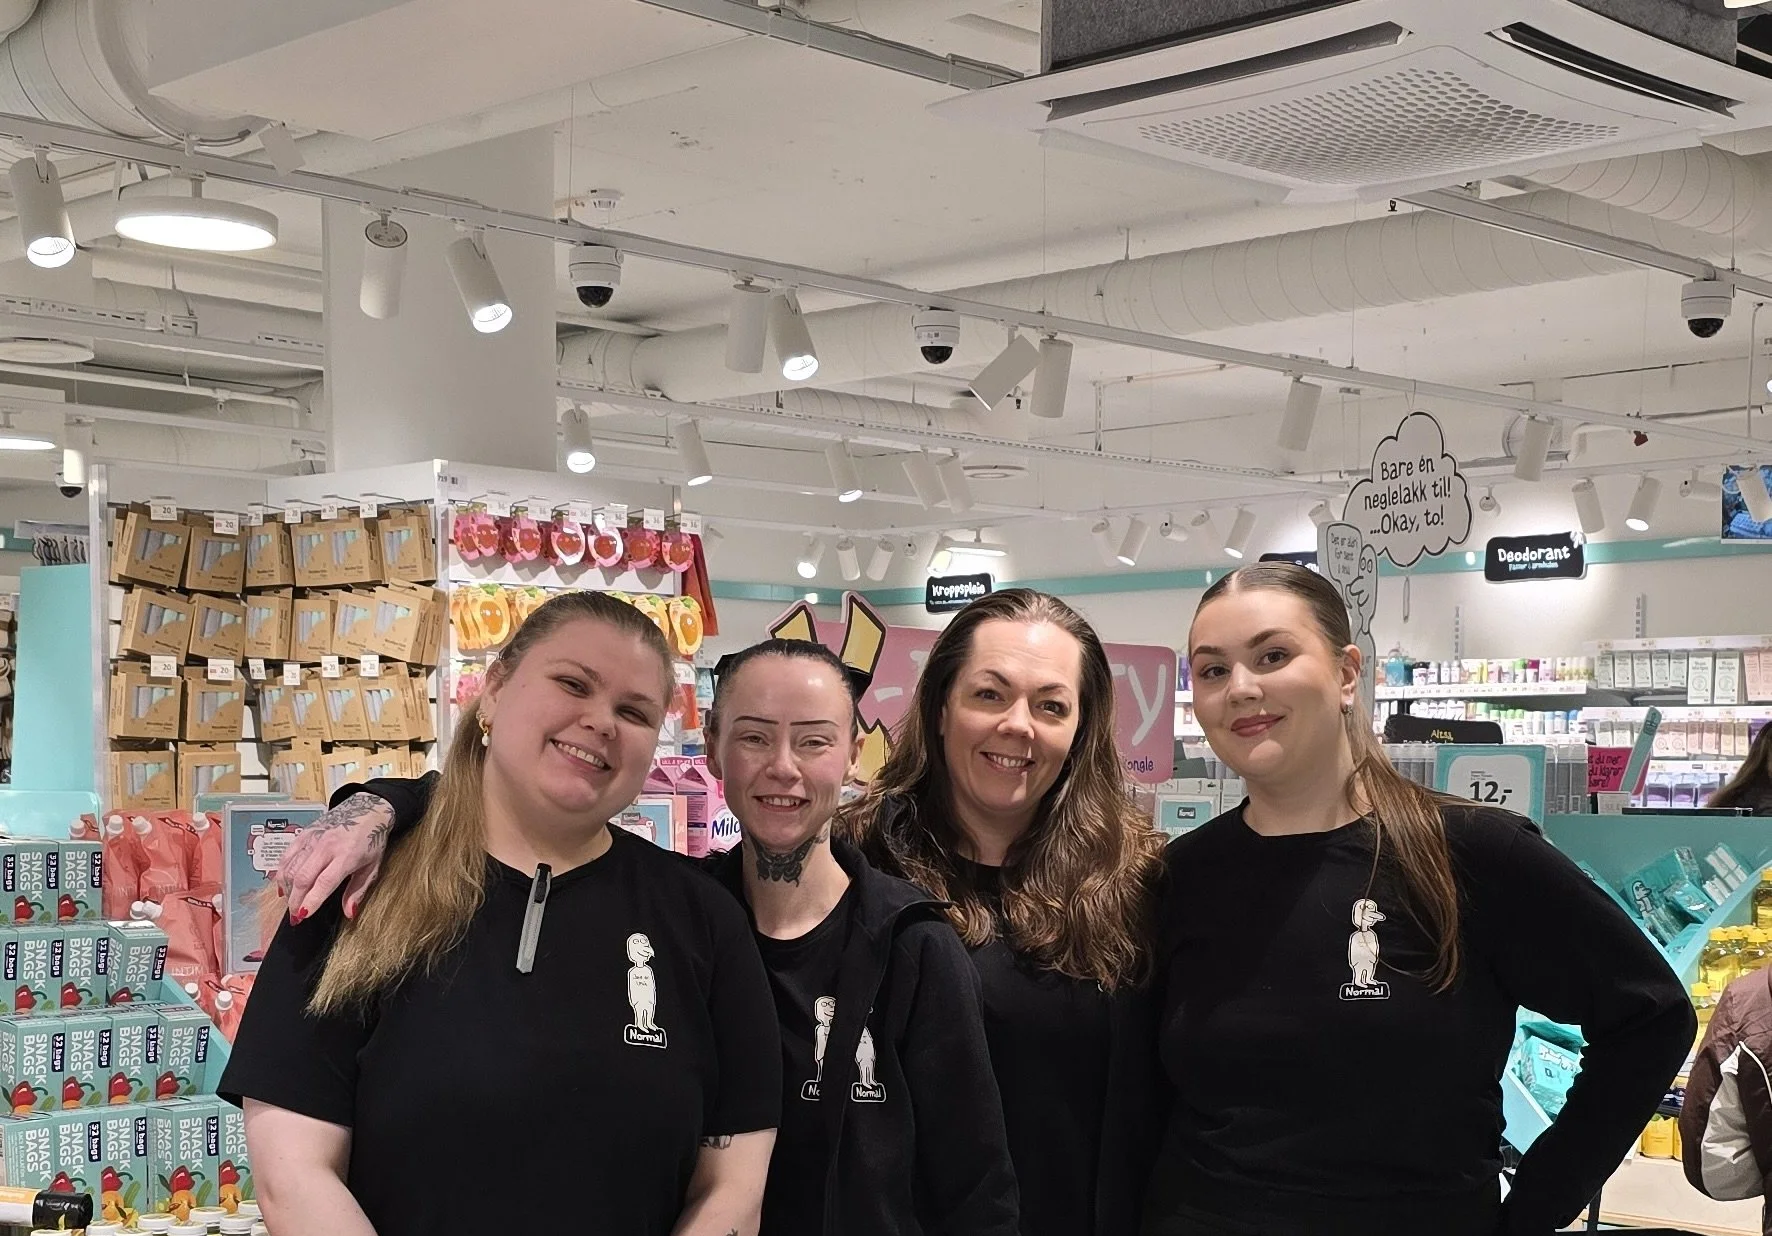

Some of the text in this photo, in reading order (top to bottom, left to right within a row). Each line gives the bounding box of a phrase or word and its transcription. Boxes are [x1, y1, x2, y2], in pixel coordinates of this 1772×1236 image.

[1381, 455, 1435, 480] Bare én
[1364, 476, 1451, 511] neglelakk til!
[1370, 504, 1444, 534] ...Okay, to!
[1497, 546, 1571, 562] Deodorant
[932, 582, 986, 598] Kroppspleie
[19, 852, 31, 891] BAGS
[32, 852, 43, 900] SNACK
[65, 851, 76, 889] BAGS
[76, 851, 88, 898] SNACK
[23, 940, 35, 980] BAGS
[34, 940, 47, 989] SNACK
[69, 938, 81, 977] BAGS
[80, 938, 93, 987] SNACK
[125, 946, 141, 983] BAGS
[134, 945, 153, 992] SNACK
[1345, 986, 1384, 997] Normal
[22, 1034, 35, 1076] BAGS
[70, 1031, 83, 1072] BAGS
[82, 1029, 95, 1081] SNACK
[118, 1026, 131, 1067] BAGS
[129, 1025, 142, 1077] SNACK
[168, 1028, 183, 1068] BAGS
[177, 1026, 194, 1076] SNACK
[629, 1028, 663, 1043] Normal
[34, 1033, 48, 1085] SNACK
[855, 1086, 882, 1098] Normal
[25, 1130, 39, 1173] BAGS
[38, 1127, 53, 1183] SNACK
[58, 1124, 72, 1167] BAGS
[71, 1122, 85, 1177] SNACK
[106, 1119, 119, 1161] BAGS
[118, 1117, 131, 1170] SNACK
[163, 1119, 173, 1171] SNACK
[179, 1118, 192, 1160] BAGS
[191, 1117, 204, 1169] SNACK
[225, 1113, 237, 1155] BAGS
